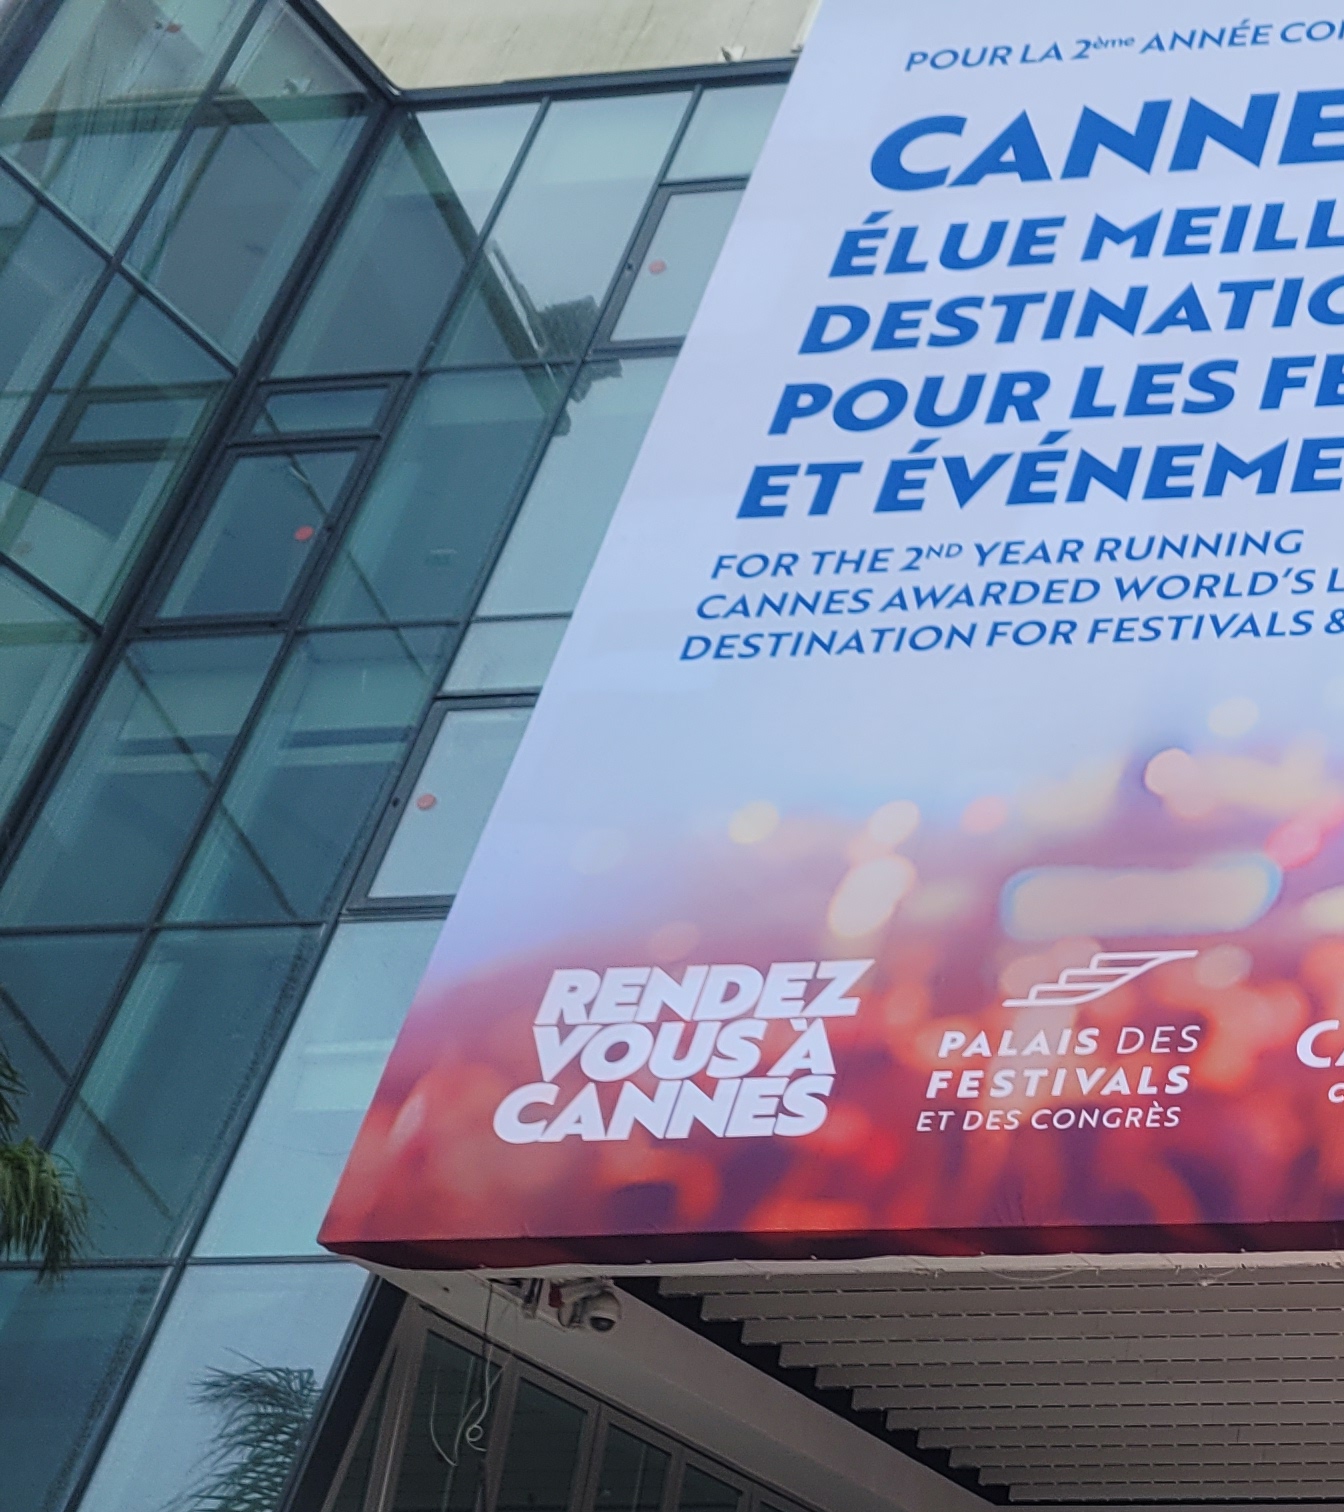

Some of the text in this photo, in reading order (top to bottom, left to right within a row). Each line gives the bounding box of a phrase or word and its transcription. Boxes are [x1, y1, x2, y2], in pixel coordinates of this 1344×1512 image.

[905, 45, 1013, 72] POUR
[1019, 42, 1064, 65] LA
[1140, 19, 1273, 54] ANNÉE
[827, 209, 1068, 279] ÉLUE
[767, 369, 1053, 437] POUR
[1067, 358, 1240, 421] LES
[735, 459, 865, 521] ET
[709, 528, 1305, 581] FOR THE 2ND YEAR RUNNING
[695, 586, 875, 621] CANNES
[879, 577, 1102, 614] AWARDED
[1113, 566, 1317, 602] WORLD'S
[677, 621, 979, 663] DESTINATION
[985, 618, 1079, 649] FOR
[1086, 608, 1316, 645] FESTIVALS
[534, 959, 875, 1025] RENDEZ
[533, 1017, 836, 1082] VOUS À
[937, 1025, 1201, 1058] PALAIS DES
[926, 1065, 1190, 1098] FESTIVALS
[493, 1075, 835, 1144] CANNES
[916, 1101, 1181, 1132] ET DES CONGRÈS
